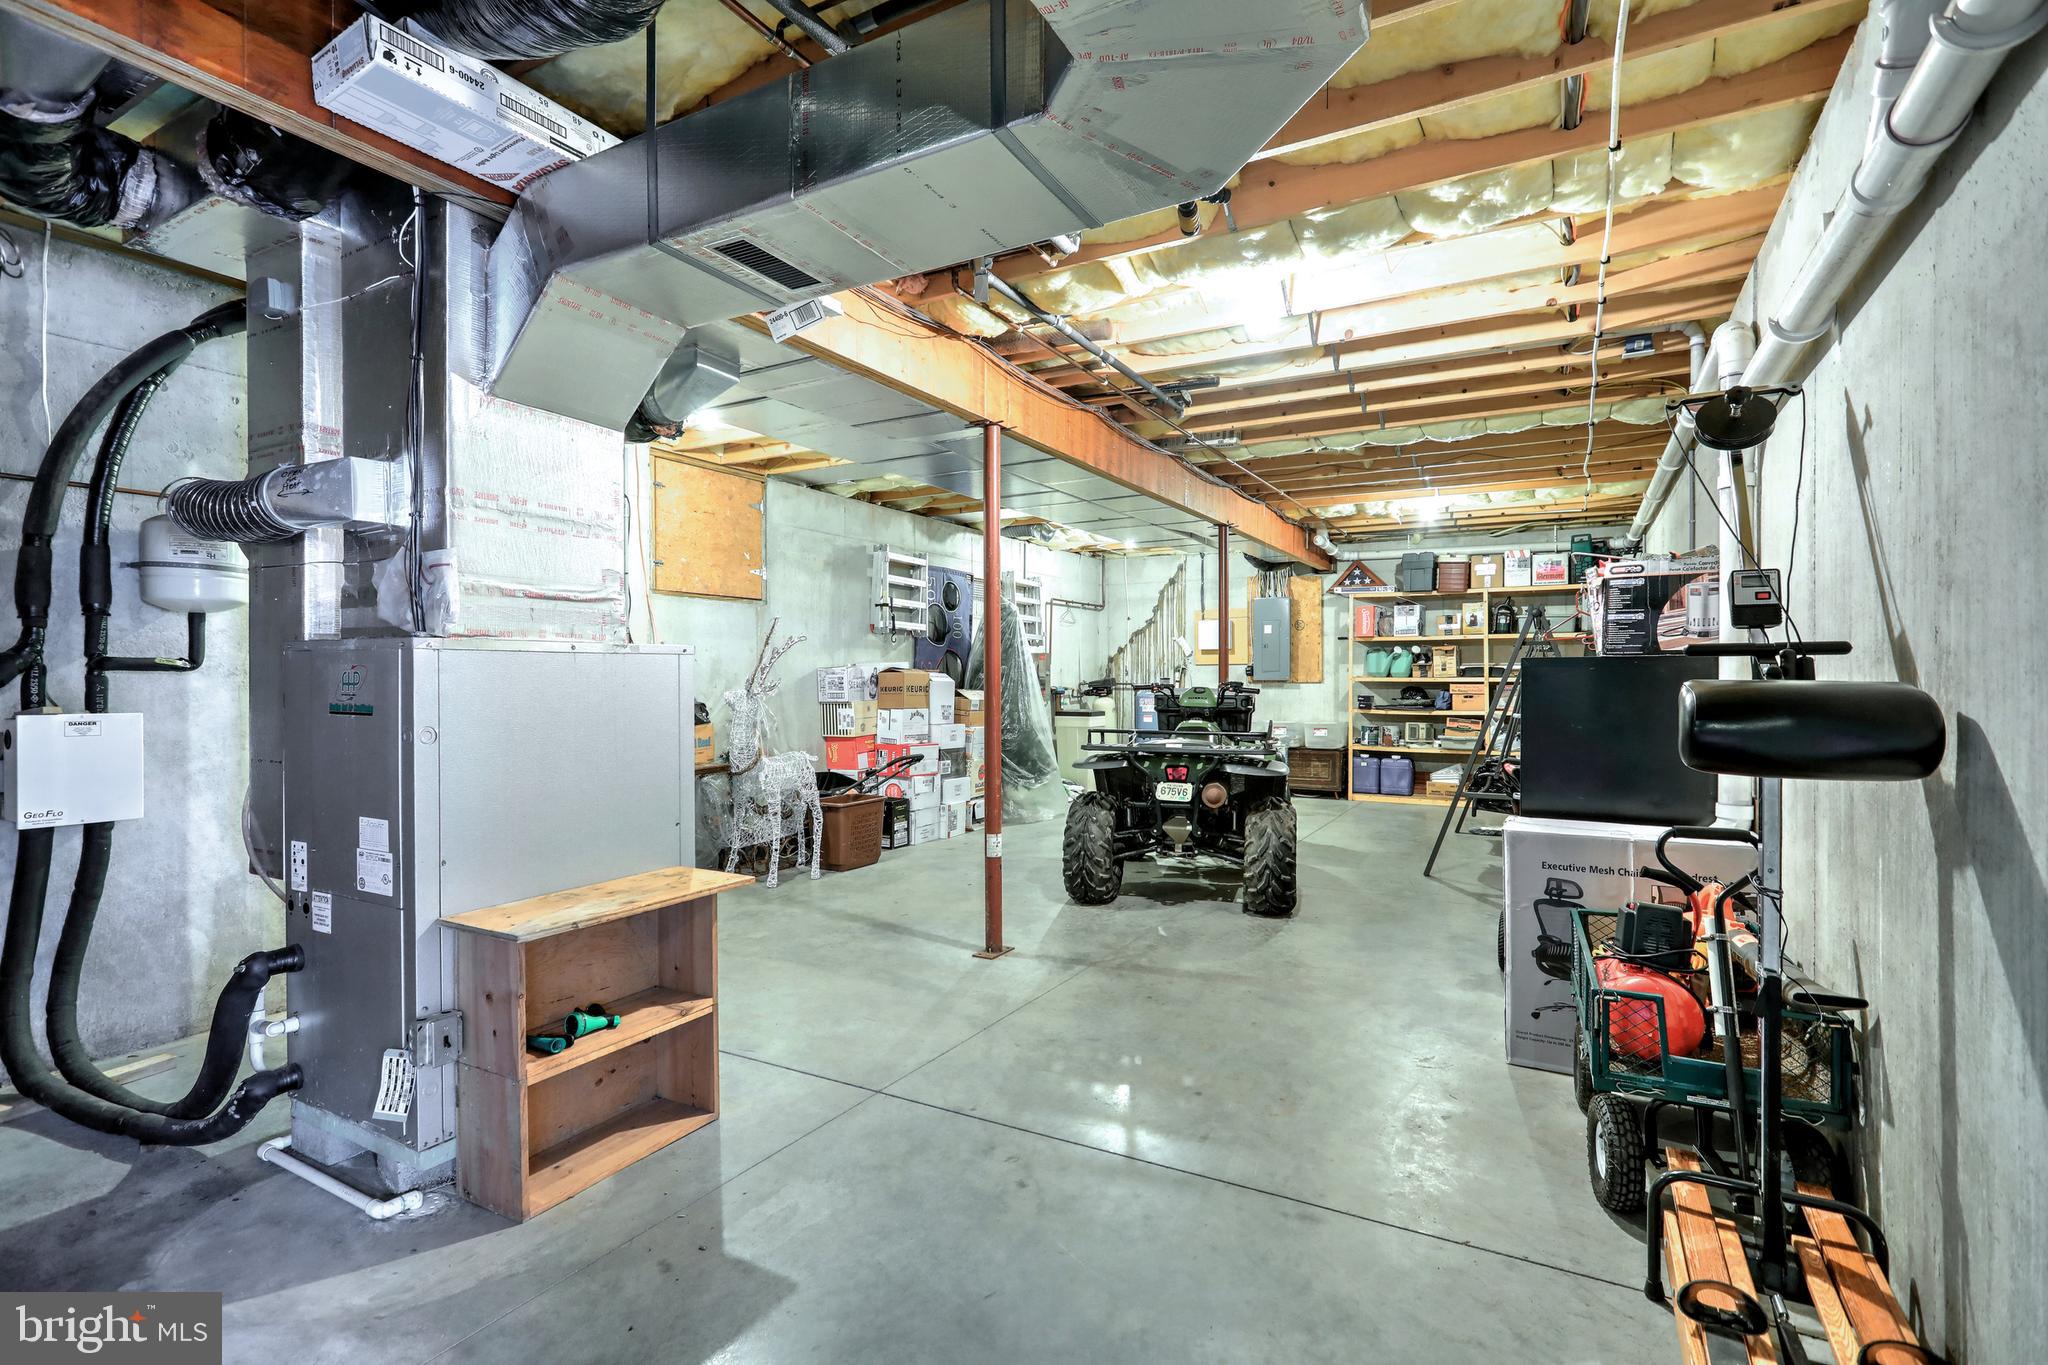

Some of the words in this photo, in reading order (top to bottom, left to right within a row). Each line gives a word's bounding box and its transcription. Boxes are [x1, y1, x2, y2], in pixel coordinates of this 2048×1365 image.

[449, 65, 485, 90] 24400-6
[512, 158, 570, 192] SYLVANIA
[769, 311, 789, 325] 24400-6
[906, 685, 929, 693] KEURIG
[1160, 786, 1188, 797] 675V6
[1541, 861, 1587, 874] Executive
[1589, 865, 1615, 876] Mesh
[1617, 867, 1640, 878] Chai
